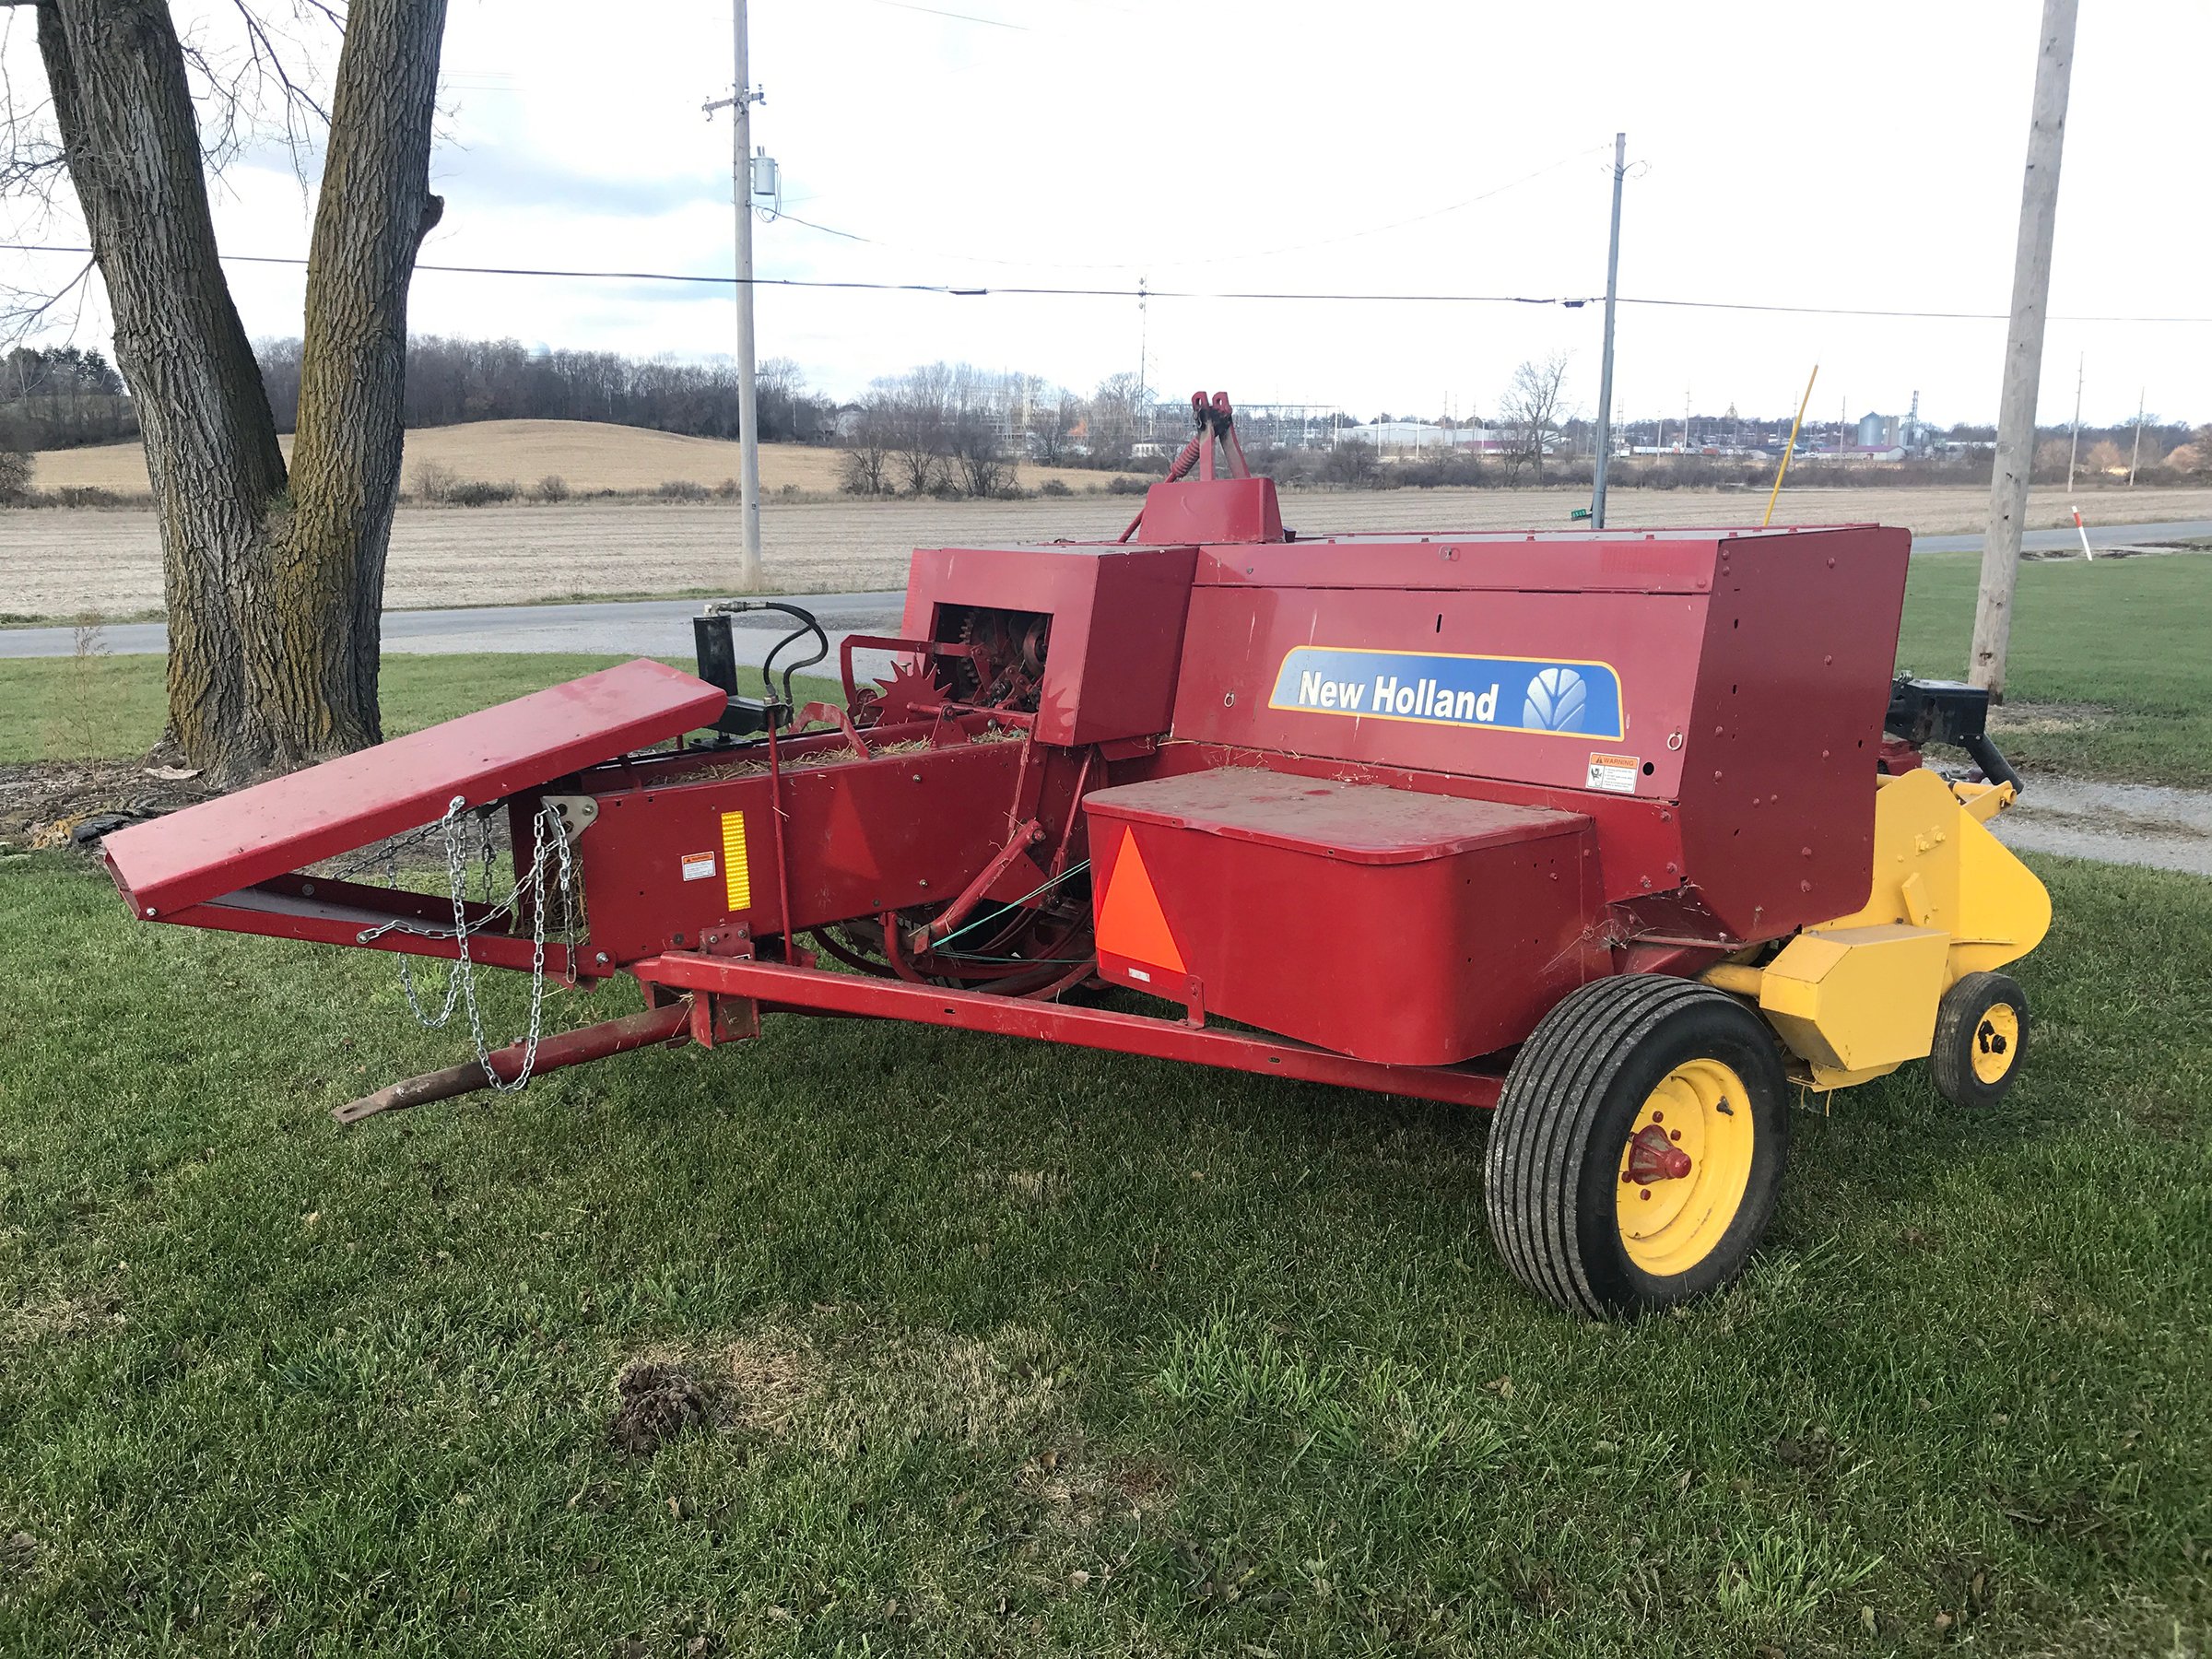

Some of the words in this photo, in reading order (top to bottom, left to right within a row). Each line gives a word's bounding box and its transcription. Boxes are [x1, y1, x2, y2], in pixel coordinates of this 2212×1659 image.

[1298, 670, 1365, 709] New
[1371, 675, 1500, 722] Holland
[1604, 757, 1634, 766] WARNING
